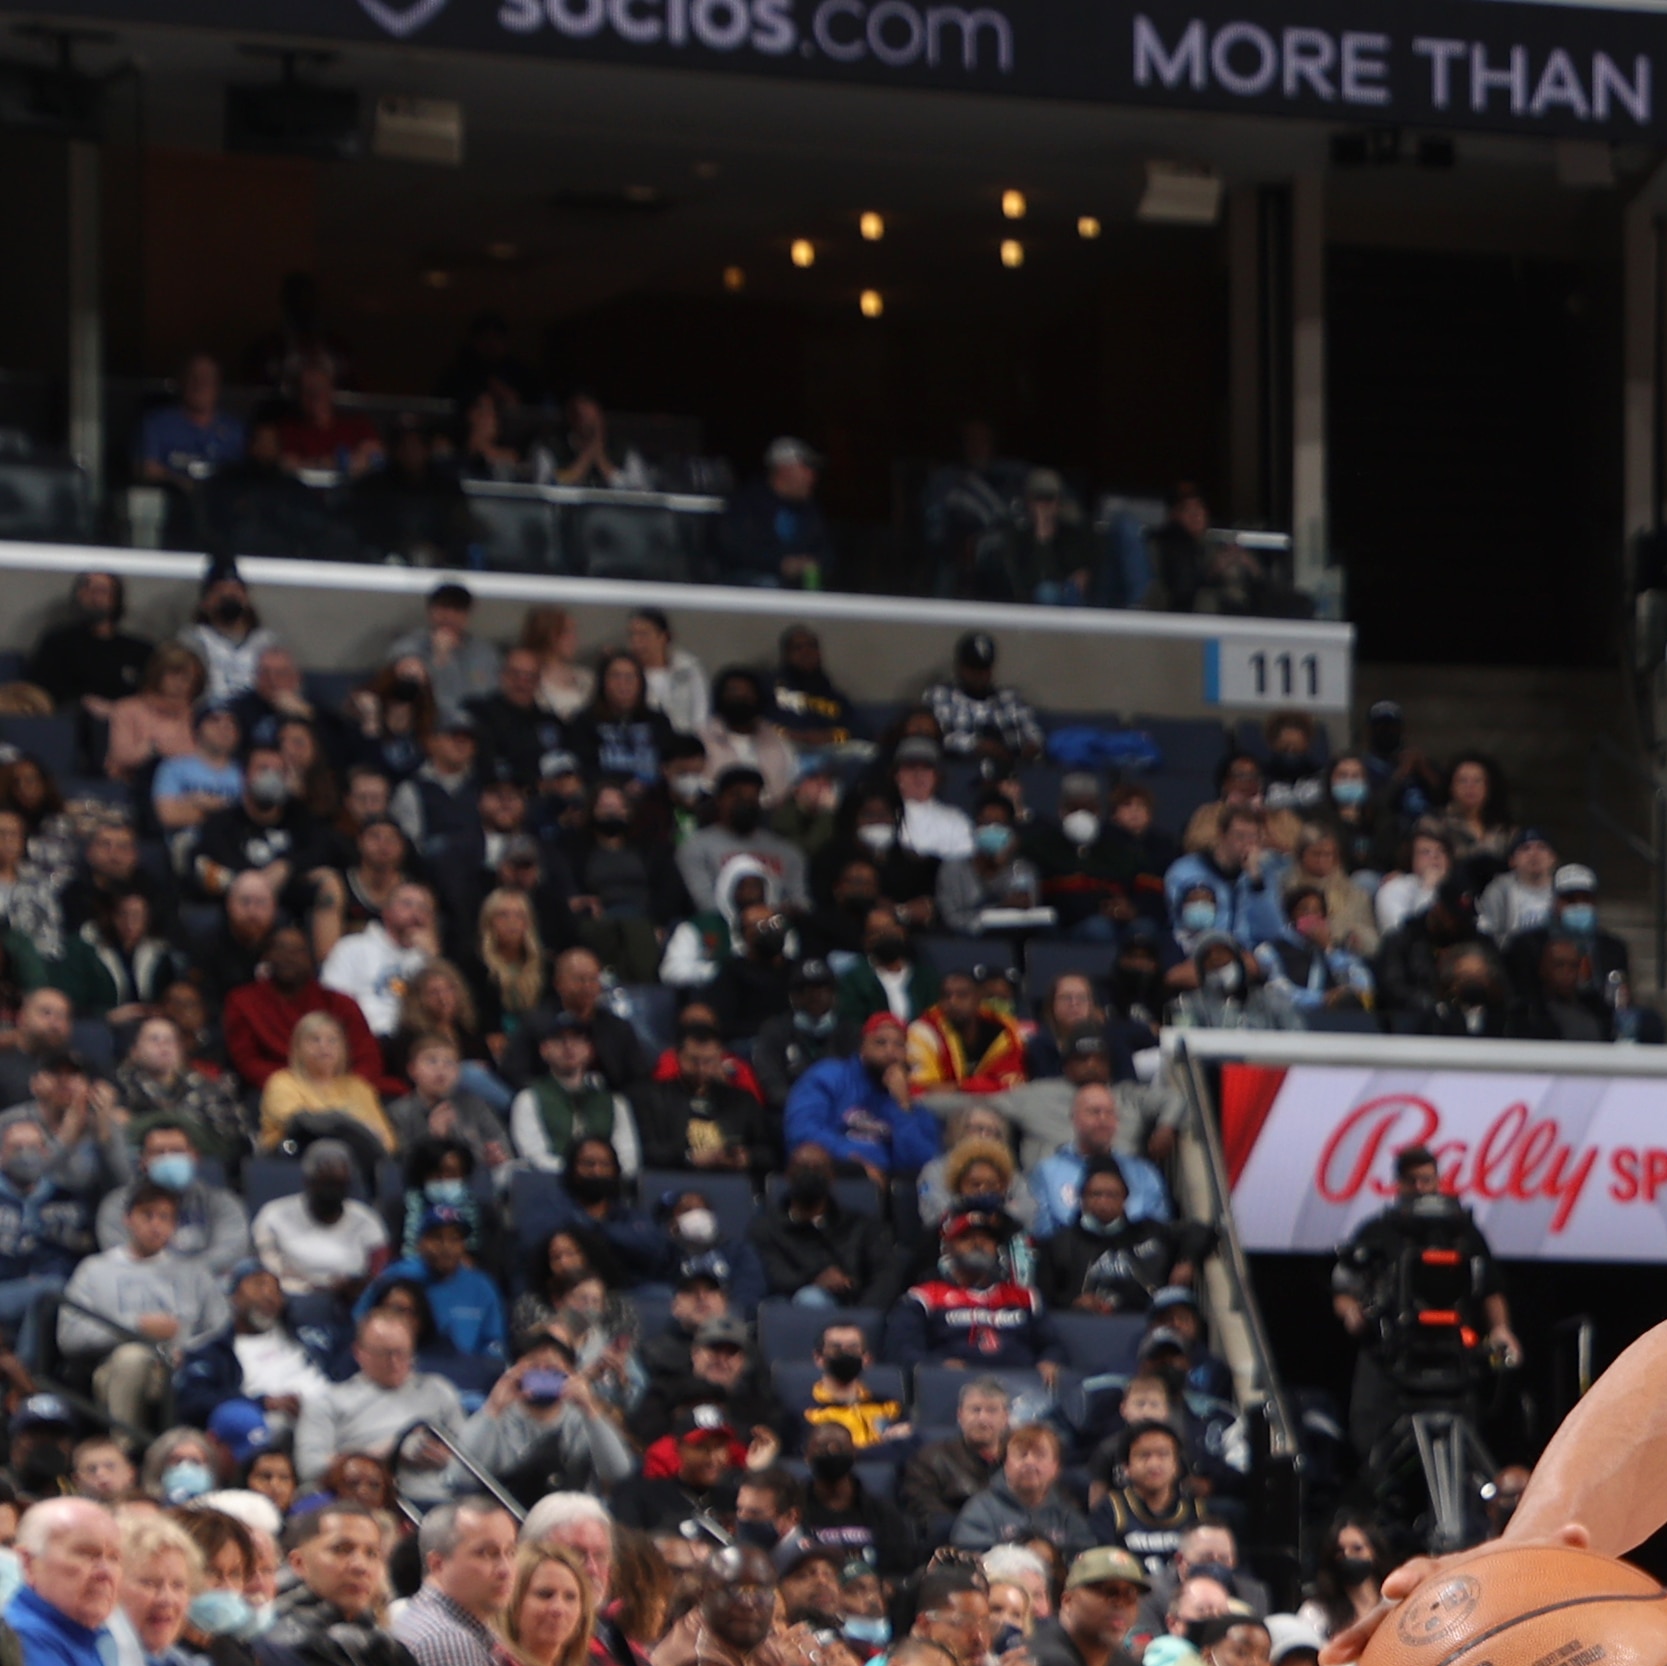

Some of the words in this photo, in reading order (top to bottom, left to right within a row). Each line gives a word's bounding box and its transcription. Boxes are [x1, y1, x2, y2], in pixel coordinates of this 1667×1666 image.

[1133, 15, 1391, 105] MORE
[1414, 37, 1650, 124] THAN
[1248, 652, 1321, 698] 111
[1315, 1093, 1600, 1235] Bally
